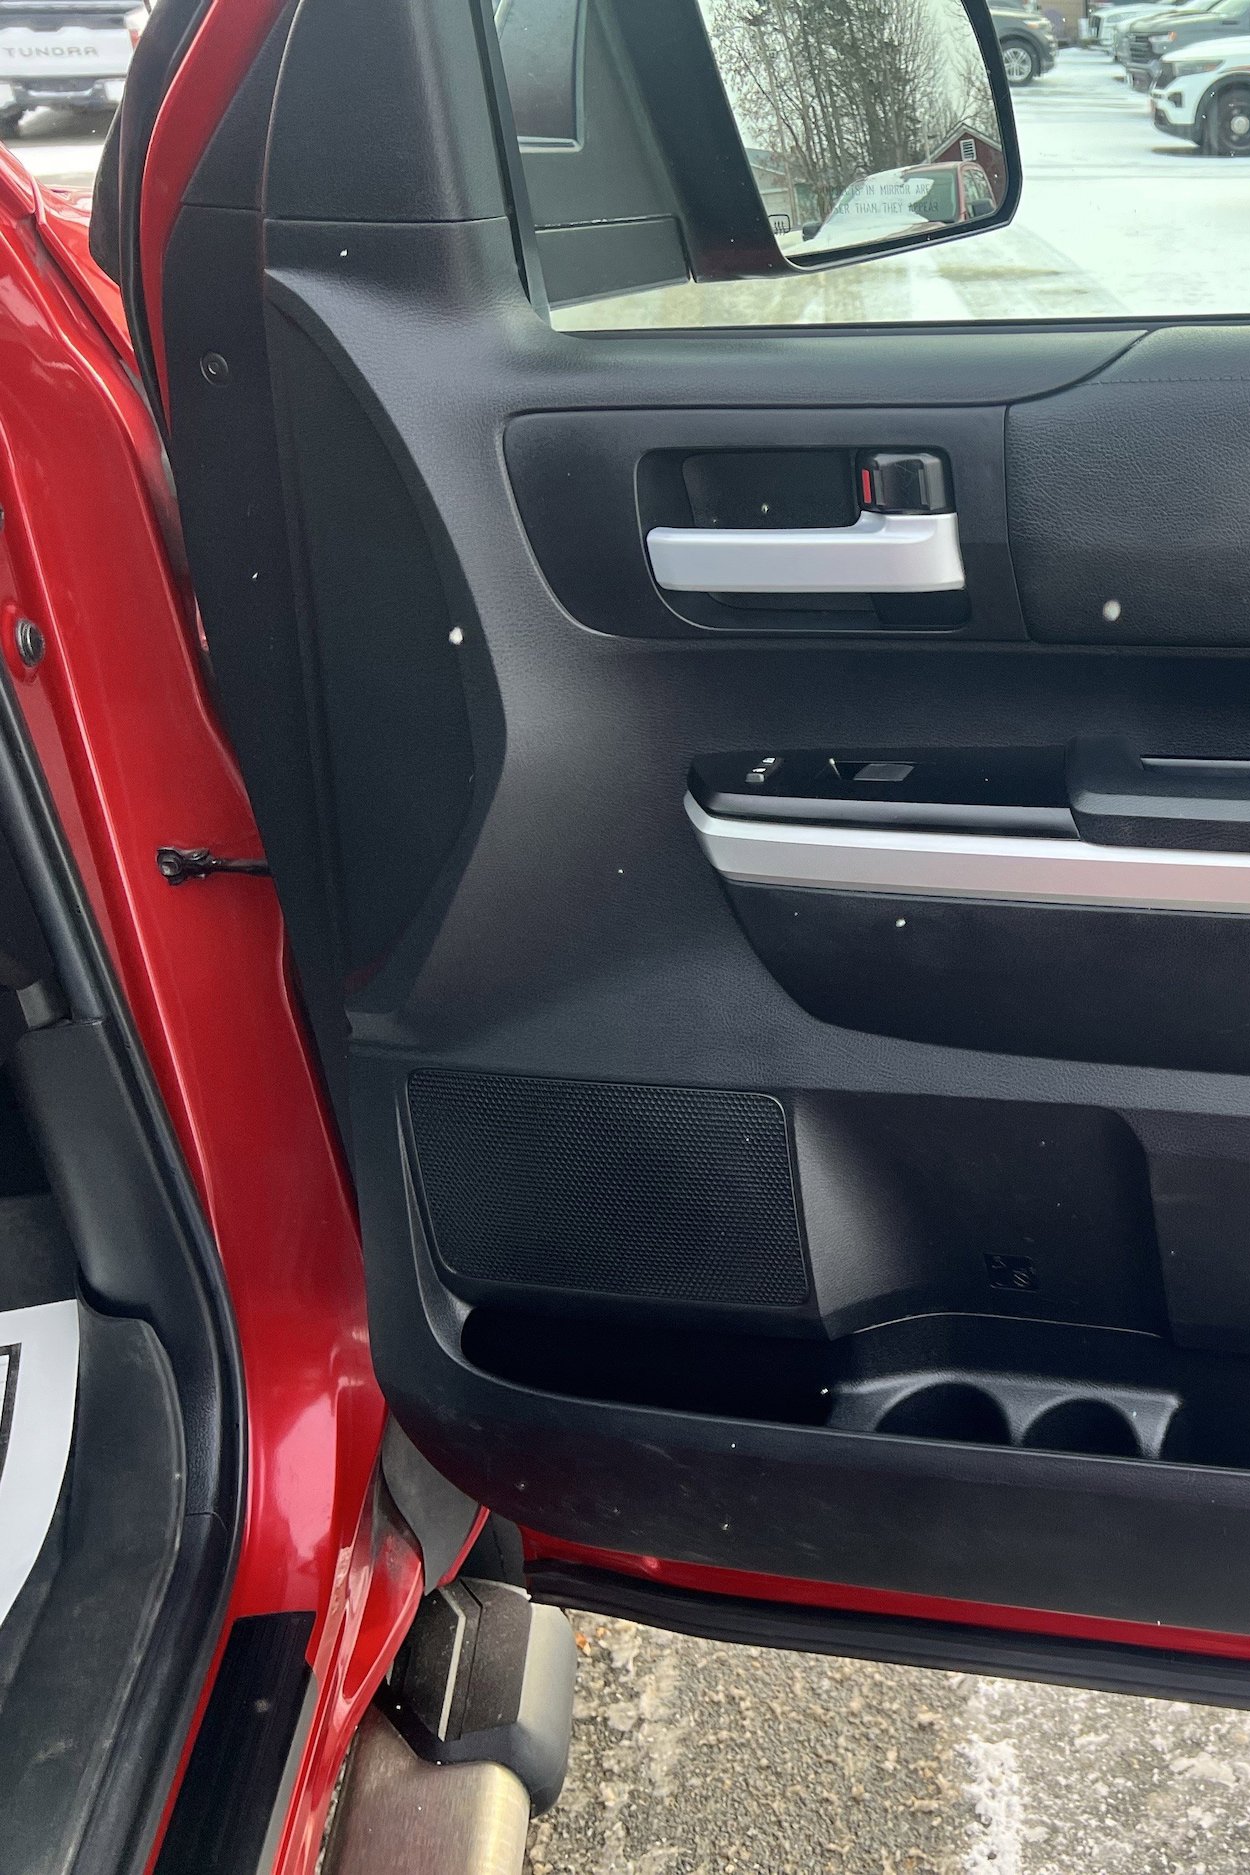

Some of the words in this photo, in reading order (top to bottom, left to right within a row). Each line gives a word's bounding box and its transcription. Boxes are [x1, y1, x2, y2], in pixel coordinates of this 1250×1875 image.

[2, 46, 99, 58] TUNDRA
[866, 184, 875, 195] IN
[880, 184, 911, 195] MIRROR
[915, 184, 931, 195] ARE
[856, 203, 878, 213] THAN
[883, 202, 903, 213] THEY
[908, 202, 939, 213] APPEAR
